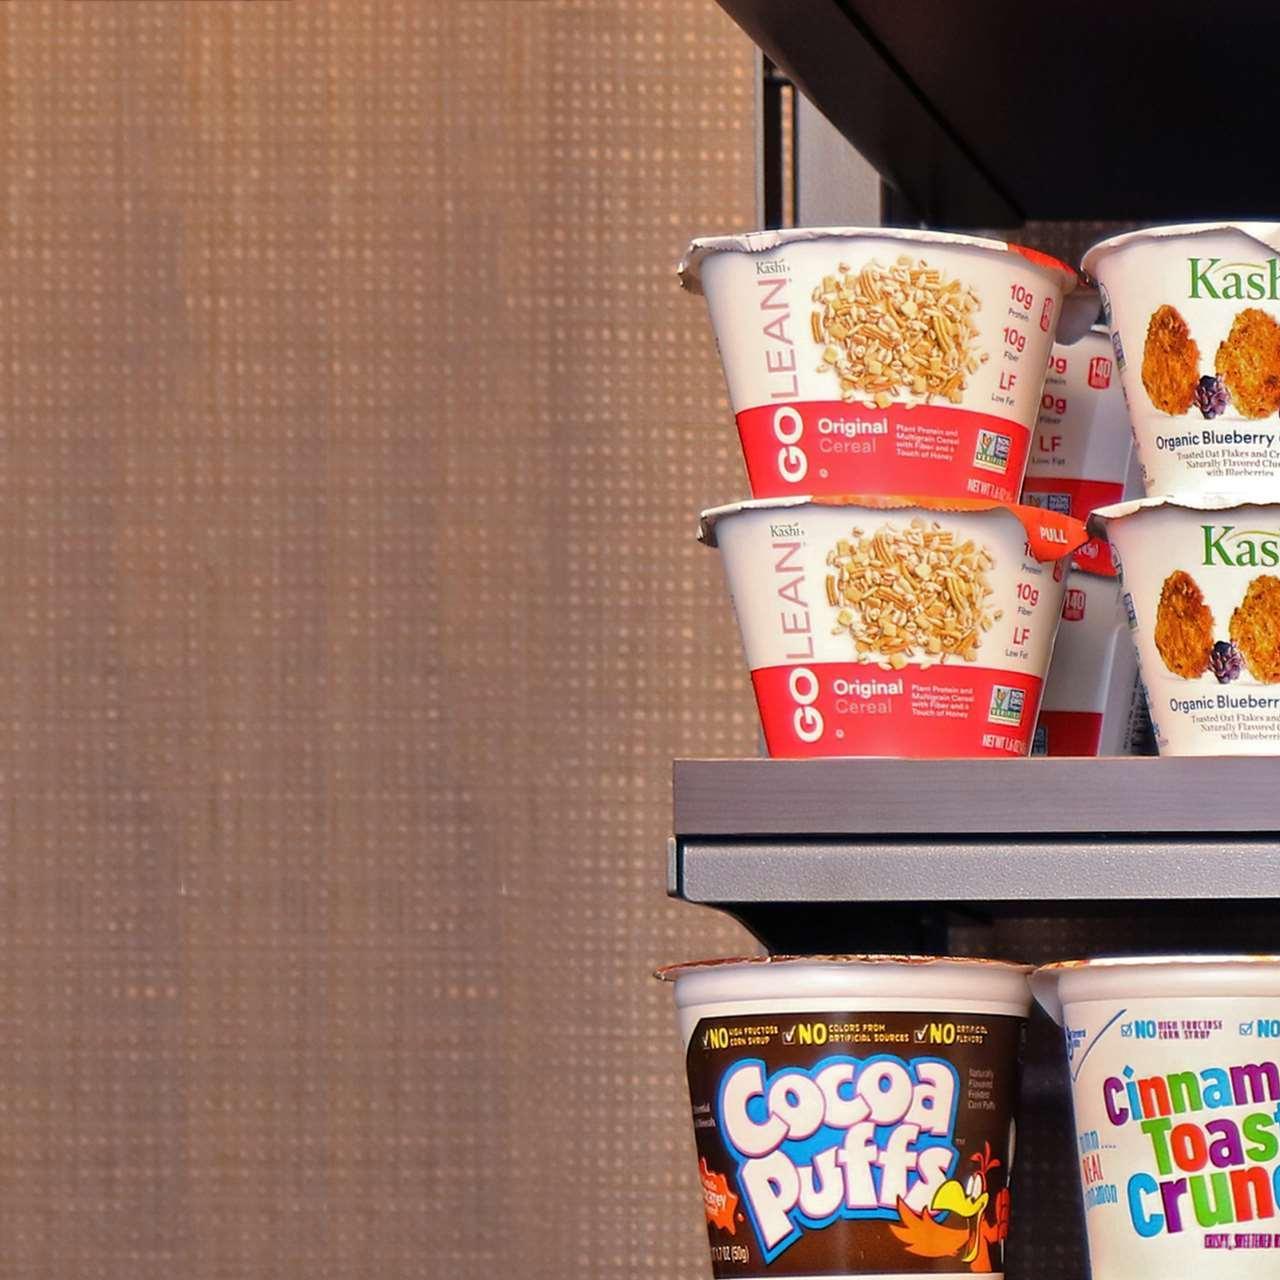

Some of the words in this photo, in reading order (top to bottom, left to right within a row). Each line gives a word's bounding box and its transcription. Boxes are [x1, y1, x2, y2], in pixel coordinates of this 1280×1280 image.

[1011, 284, 1033, 310] 10g
[759, 278, 799, 399] LEAN
[1003, 327, 1025, 353] 10g
[818, 417, 888, 437] Original
[773, 406, 808, 483] GO
[820, 438, 877, 454] Cereal
[1156, 432, 1199, 452] Organic
[1202, 430, 1275, 447] Blueberry
[1040, 527, 1068, 544] PULL
[772, 542, 814, 659] LEAN
[1017, 584, 1039, 606] 10g
[833, 680, 903, 698] Original
[789, 667, 824, 742] GO
[835, 700, 892, 714] Cereal
[1170, 698, 1213, 713] Organic
[798, 1023, 827, 1045] NO
[829, 1024, 860, 1033] COLORS
[829, 1033, 872, 1043] ARTIFICIAL
[874, 1033, 909, 1043] SOURCES
[930, 1023, 955, 1044] NO
[1135, 1020, 1156, 1038] NO
[1257, 1020, 1280, 1038] NO
[723, 1061, 955, 1158] Cocoa
[741, 1122, 953, 1249] Puffs
